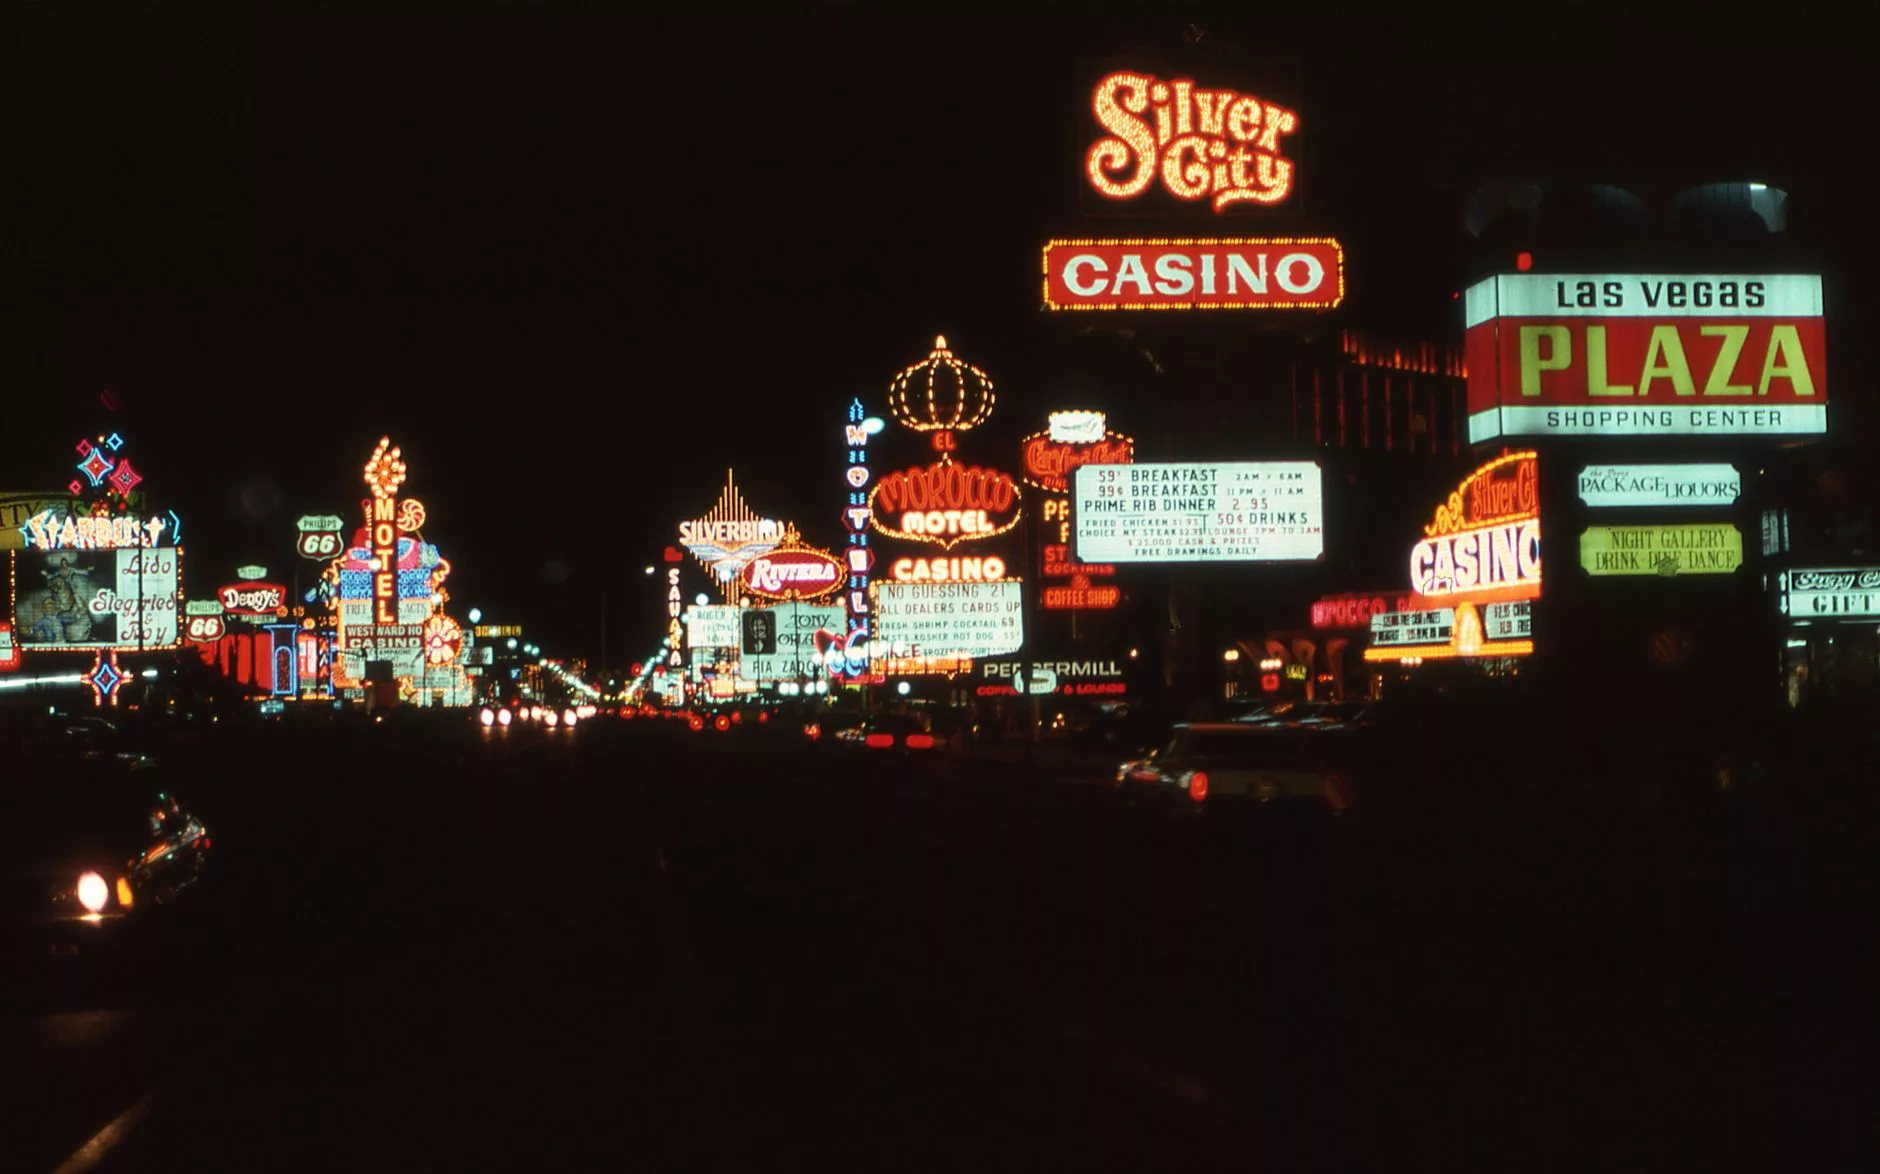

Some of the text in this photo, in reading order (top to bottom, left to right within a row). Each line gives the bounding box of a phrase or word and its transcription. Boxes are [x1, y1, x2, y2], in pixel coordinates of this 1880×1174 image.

[1087, 72, 1296, 196] Silver
[1162, 136, 1294, 212] City
[1062, 254, 1324, 296] CASINO
[1557, 281, 1765, 308] Las Vegas
[1519, 325, 1815, 396] PLAZA
[1547, 410, 1782, 428] SHOPPING CENTER
[934, 433, 954, 449] EL
[1131, 470, 1217, 482] BREAKFAST
[879, 461, 1014, 512] MOROCCO
[1132, 484, 1217, 497] BREAKFAST
[1471, 468, 1517, 521] Silver
[1581, 477, 1738, 498] PACKAGE LIQUORS
[1085, 500, 1126, 512] PRIME
[1133, 500, 1157, 511] RIB
[1163, 499, 1216, 511] DINNER
[303, 518, 338, 528] PHILLIPS
[901, 510, 993, 534] MOTEL
[1249, 512, 1308, 524] DRINKS
[24, 510, 165, 549] STARDUST
[1208, 527, 1247, 535] LOUNGE
[1611, 529, 1727, 549] NIGHT GALLERY
[304, 535, 335, 553] 66
[1167, 547, 1221, 555] DRAWINGS
[1228, 547, 1257, 555] DAILY
[122, 554, 171, 575] Lido
[375, 499, 395, 622] MOTEL
[894, 556, 1006, 581] CASINO
[1596, 552, 1639, 570] DRINK
[1689, 550, 1735, 569] DANCE
[751, 559, 835, 590] RIVIERA
[223, 589, 280, 612] Denny's
[888, 586, 904, 599] NO
[912, 585, 979, 597] GUESSING
[1046, 590, 1117, 605] COFFEE SHOP
[93, 592, 176, 617] Siegfried
[881, 601, 1020, 614] ALL DEALERS CARDS UP
[1813, 595, 1875, 612] GIFT
[668, 568, 682, 666] SAHARA
[791, 614, 831, 631] TONY
[914, 621, 949, 629] SHRIMP
[953, 620, 998, 628] COCKTAIL
[121, 621, 167, 645] Roy
[190, 618, 218, 636] 66
[408, 626, 423, 636] HO
[349, 638, 421, 648] CASINO
[1077, 684, 1125, 694] LOUNGE
